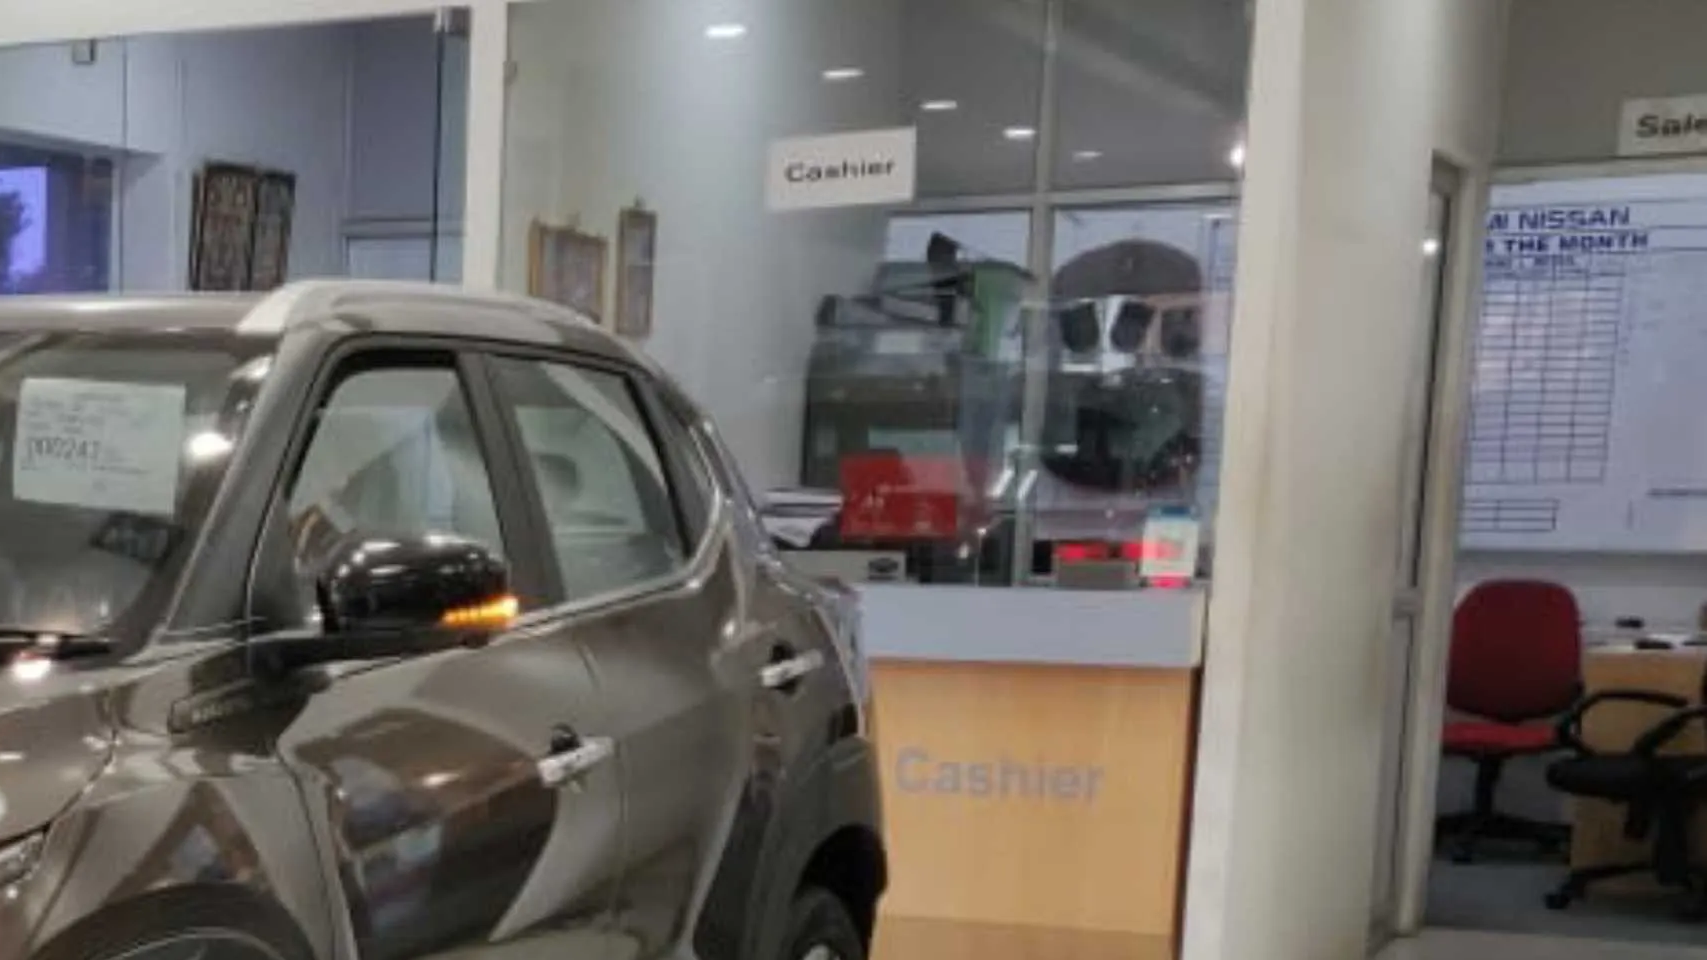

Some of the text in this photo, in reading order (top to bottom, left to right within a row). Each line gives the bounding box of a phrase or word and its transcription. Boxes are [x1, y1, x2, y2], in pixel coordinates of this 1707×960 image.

[783, 159, 896, 183] Cashier
[1518, 206, 1630, 230] NISSAN
[1504, 238, 1550, 252] THE
[1558, 233, 1648, 250] MONTH
[894, 746, 1106, 803] Cashier
